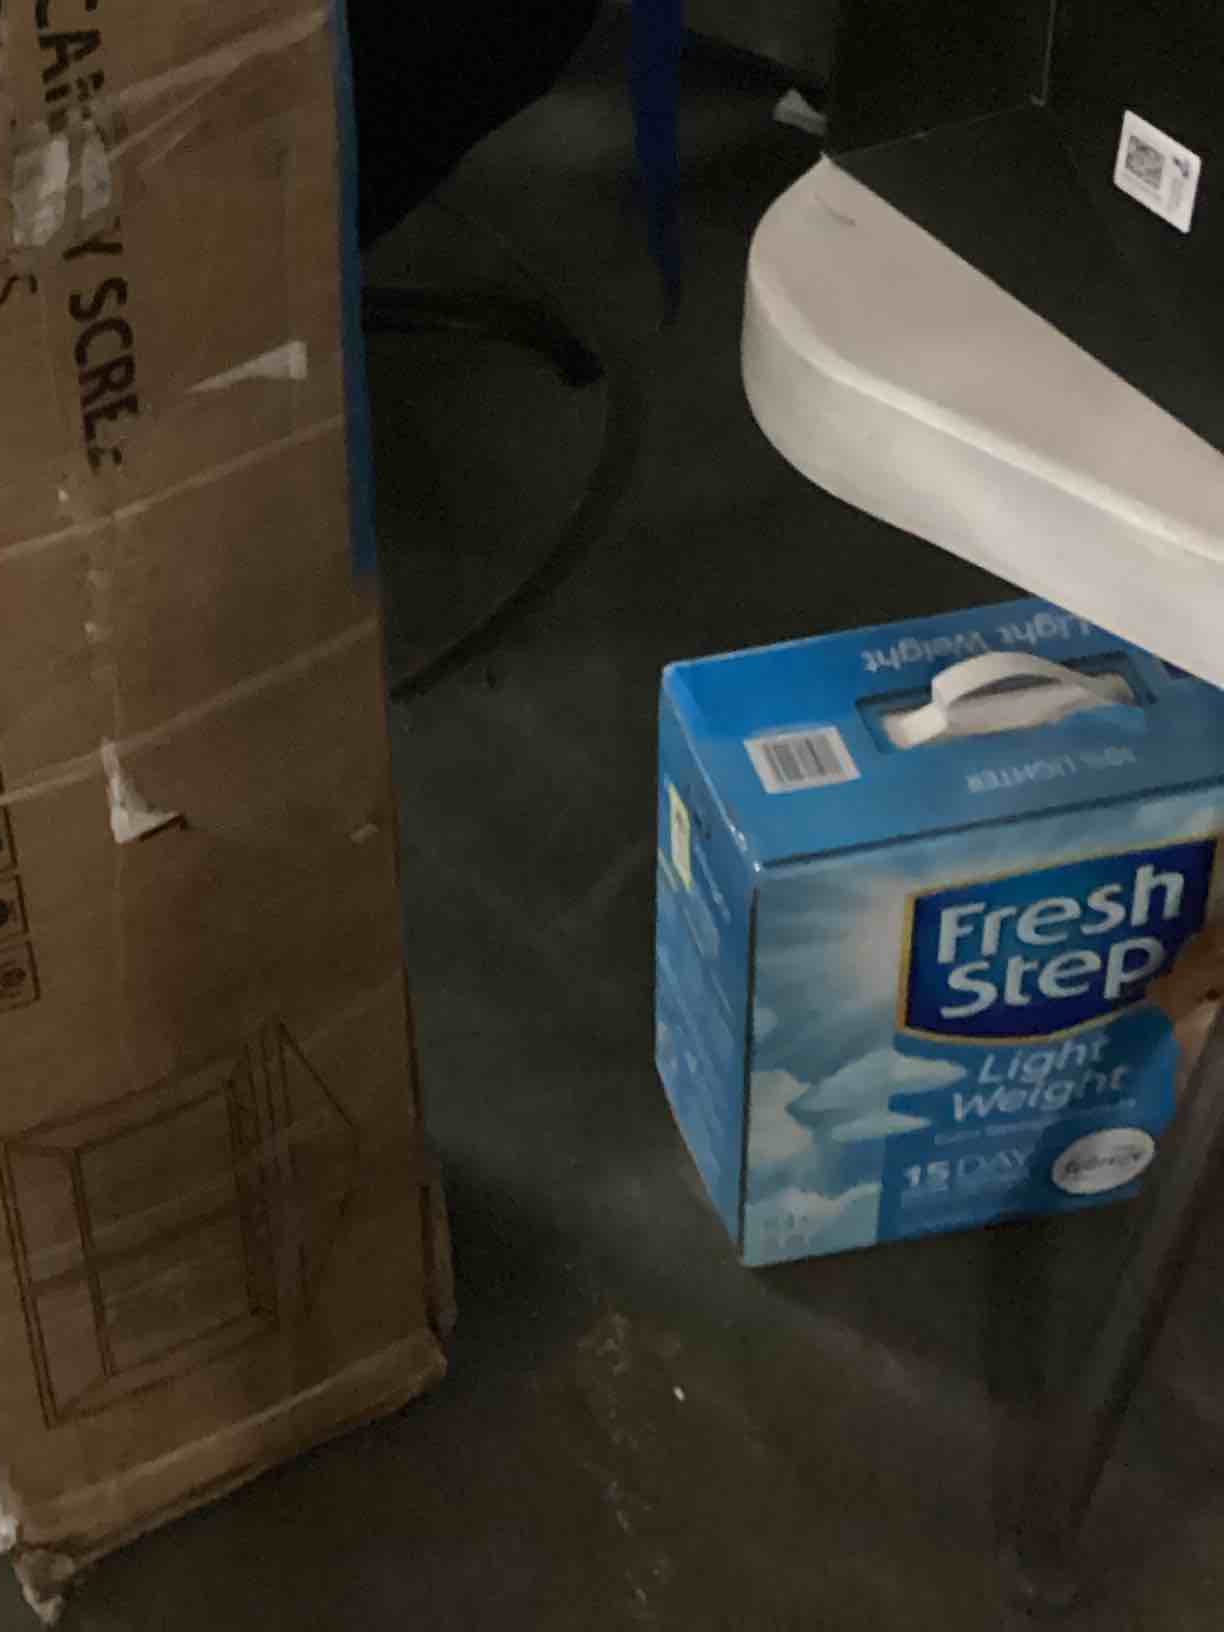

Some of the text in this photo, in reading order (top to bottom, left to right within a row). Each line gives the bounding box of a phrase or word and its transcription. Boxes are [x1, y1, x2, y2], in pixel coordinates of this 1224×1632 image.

[860, 630, 989, 674] Weight
[936, 862, 1185, 965] Fresh
[940, 933, 1169, 1019] Step
[977, 1035, 1111, 1087] Light
[951, 1065, 1128, 1121] Weight
[904, 1160, 951, 1187] 15
[957, 1148, 1032, 1178] DAY
